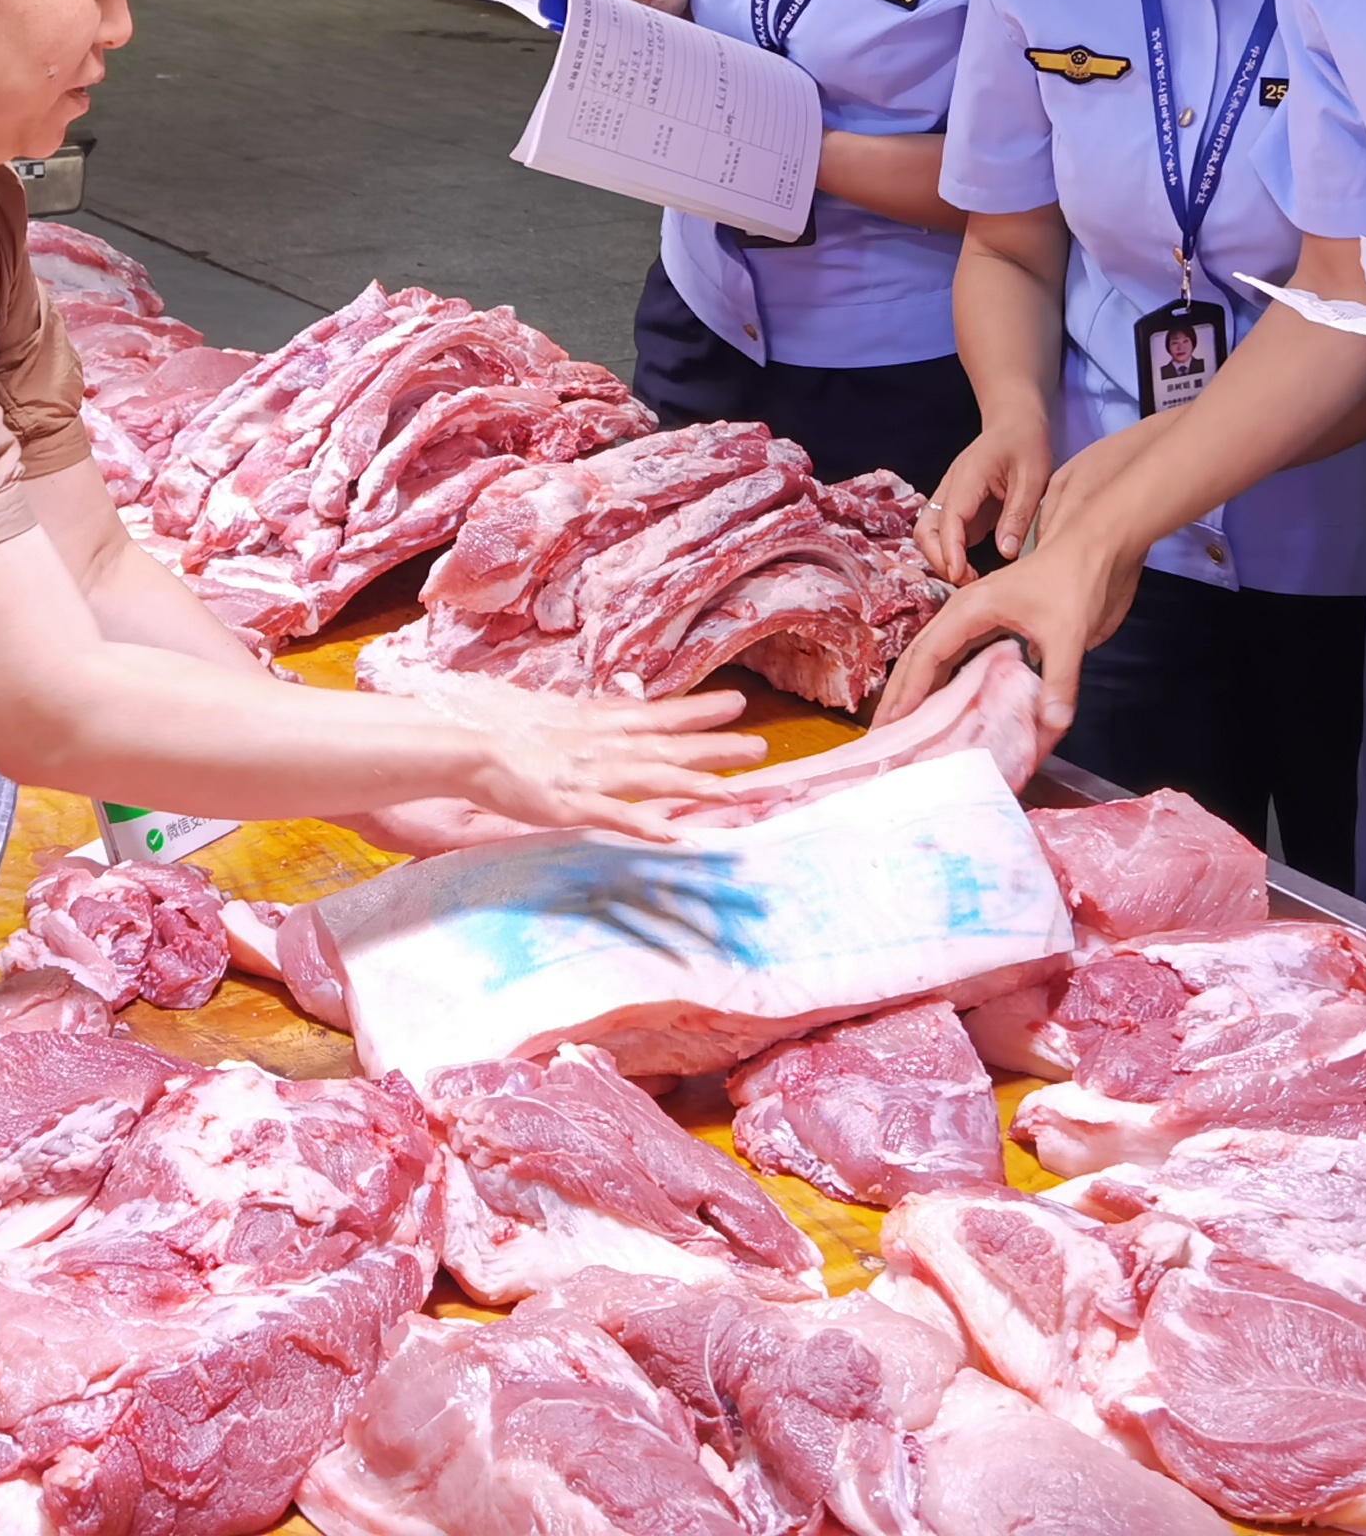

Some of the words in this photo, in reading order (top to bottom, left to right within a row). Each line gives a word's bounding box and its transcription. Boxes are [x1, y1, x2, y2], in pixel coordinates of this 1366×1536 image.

[1151, 27, 1176, 186] 中华人民共和国行政执法证
[1194, 45, 1261, 204] 中华人民共和国行政执法证
